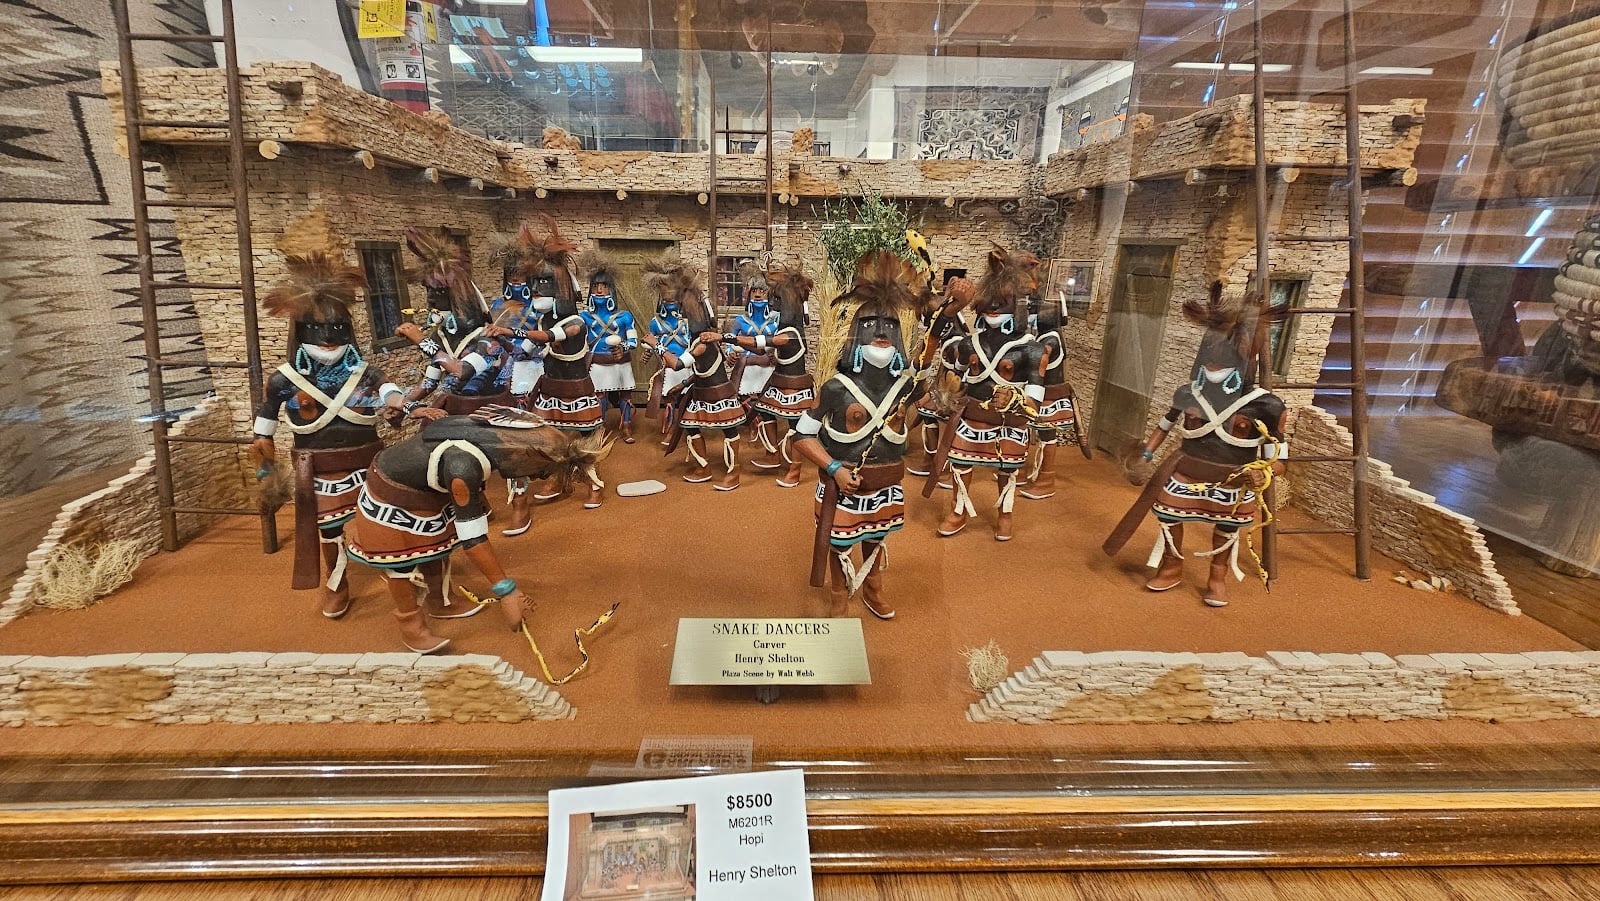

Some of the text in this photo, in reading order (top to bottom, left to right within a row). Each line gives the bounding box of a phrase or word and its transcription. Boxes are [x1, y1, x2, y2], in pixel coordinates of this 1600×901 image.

[712, 622, 830, 635] SNAKE DANCERS
[753, 639, 786, 649] Carver
[735, 653, 805, 665] Henry Shelton
[722, 669, 815, 679] Plaza Scene by Walt Webb
[727, 793, 773, 811] $8500
[728, 815, 773, 829] M6201R
[739, 833, 764, 847] Hopi
[709, 864, 797, 883] Henry Shelton
